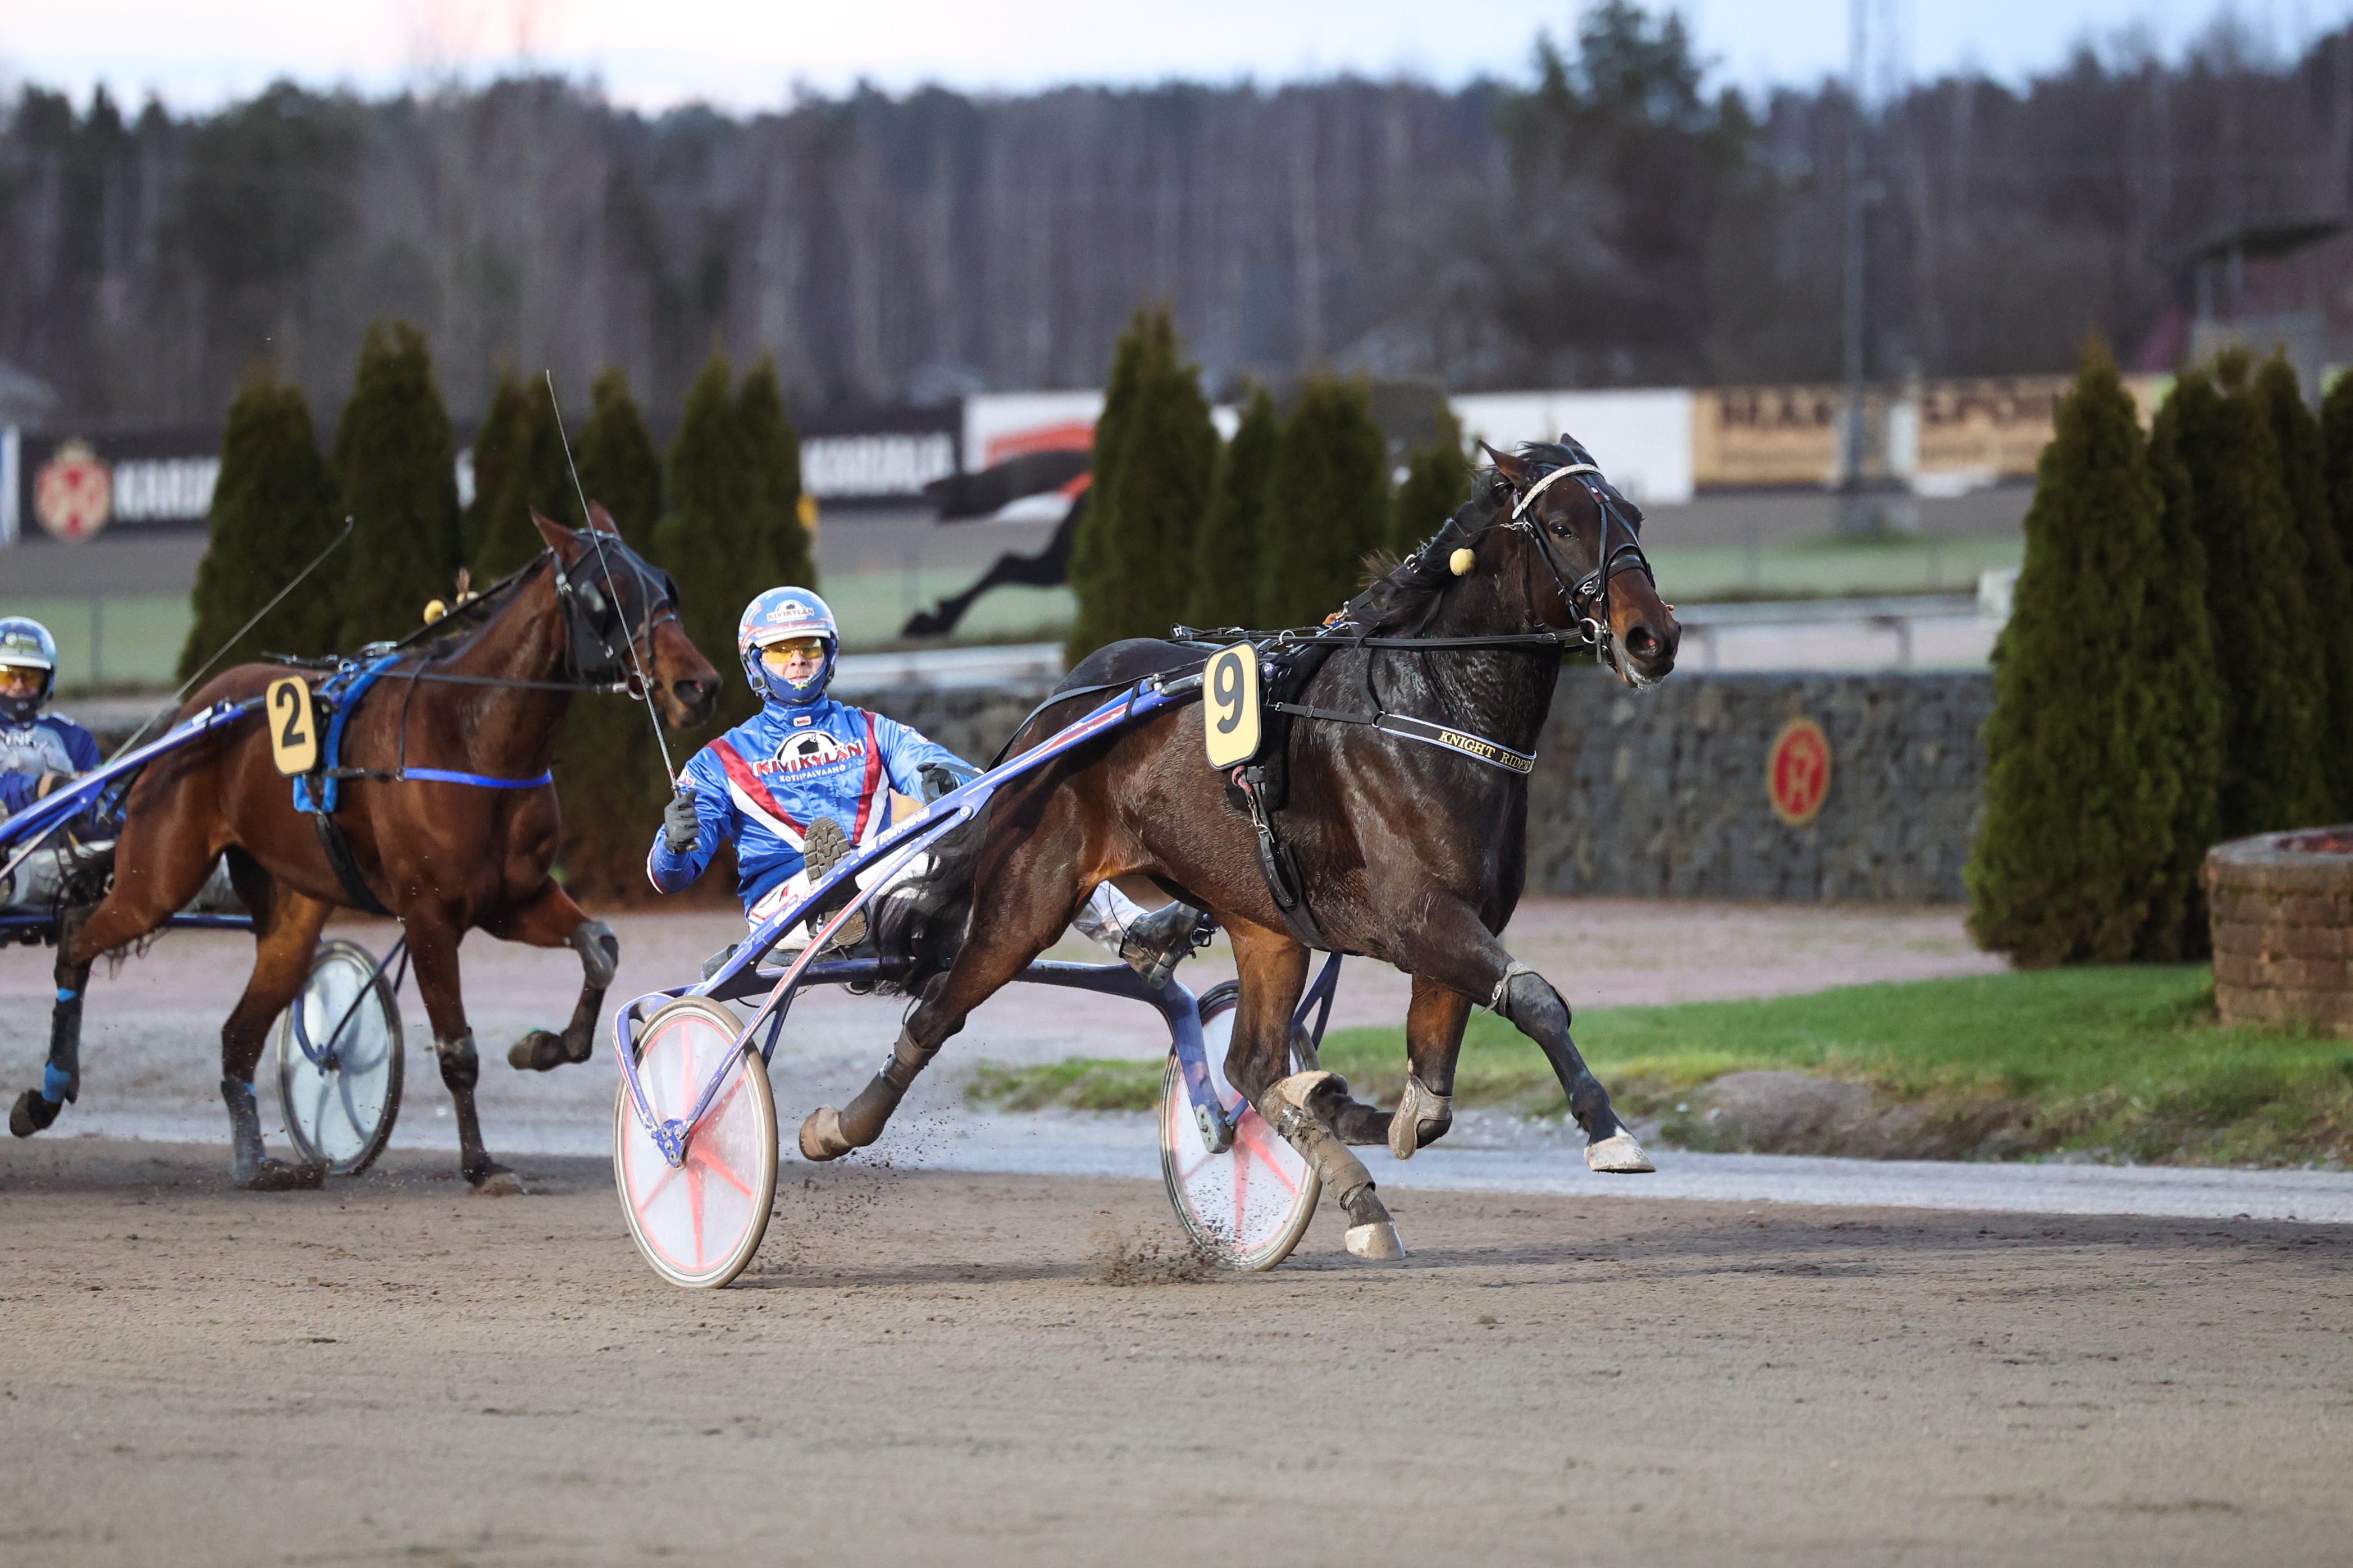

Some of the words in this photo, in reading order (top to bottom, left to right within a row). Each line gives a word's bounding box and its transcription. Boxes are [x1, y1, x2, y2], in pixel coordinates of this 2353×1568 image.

[276, 683, 306, 748] 2
[1214, 652, 1244, 734] 9
[755, 741, 863, 775] KIVIKYLÄN
[1438, 730, 1496, 758] KNIGHT
[1499, 752, 1531, 771] RIDER
